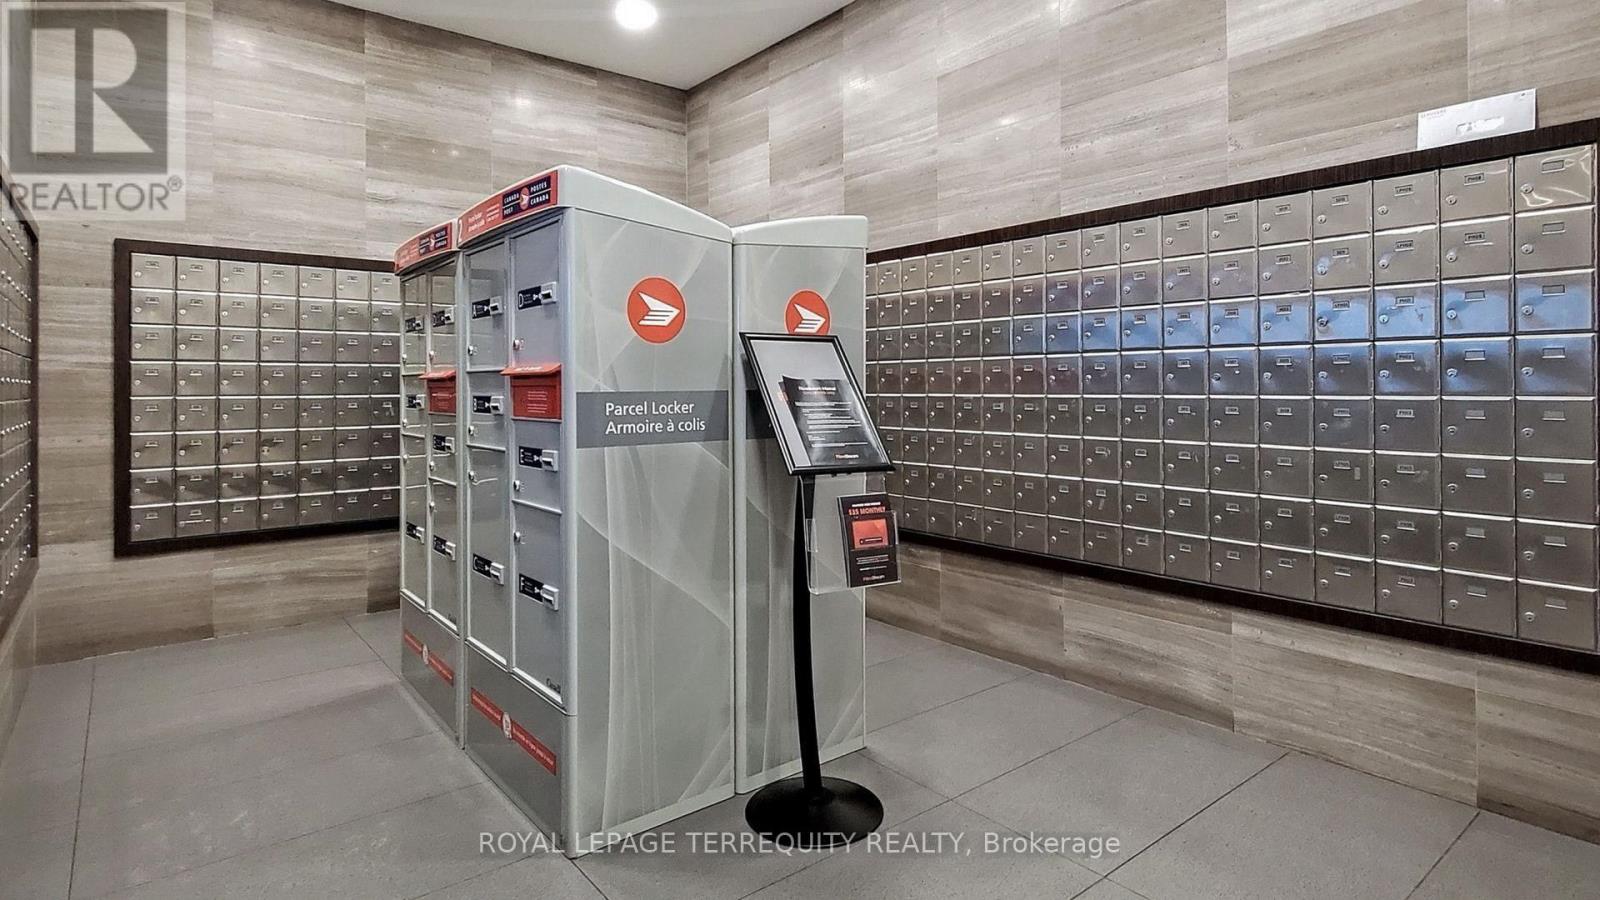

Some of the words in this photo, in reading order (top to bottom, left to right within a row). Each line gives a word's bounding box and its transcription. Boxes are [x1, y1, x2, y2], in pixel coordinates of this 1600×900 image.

[530, 181, 547, 193] POSTES
[503, 192, 520, 204] CANADA
[530, 194, 549, 206] CANADA
[503, 206, 514, 216] POST
[605, 401, 648, 416] Parcel
[652, 400, 695, 415] Locker
[605, 420, 663, 434] Armoire
[666, 419, 675, 432] à
[678, 418, 706, 432] colis
